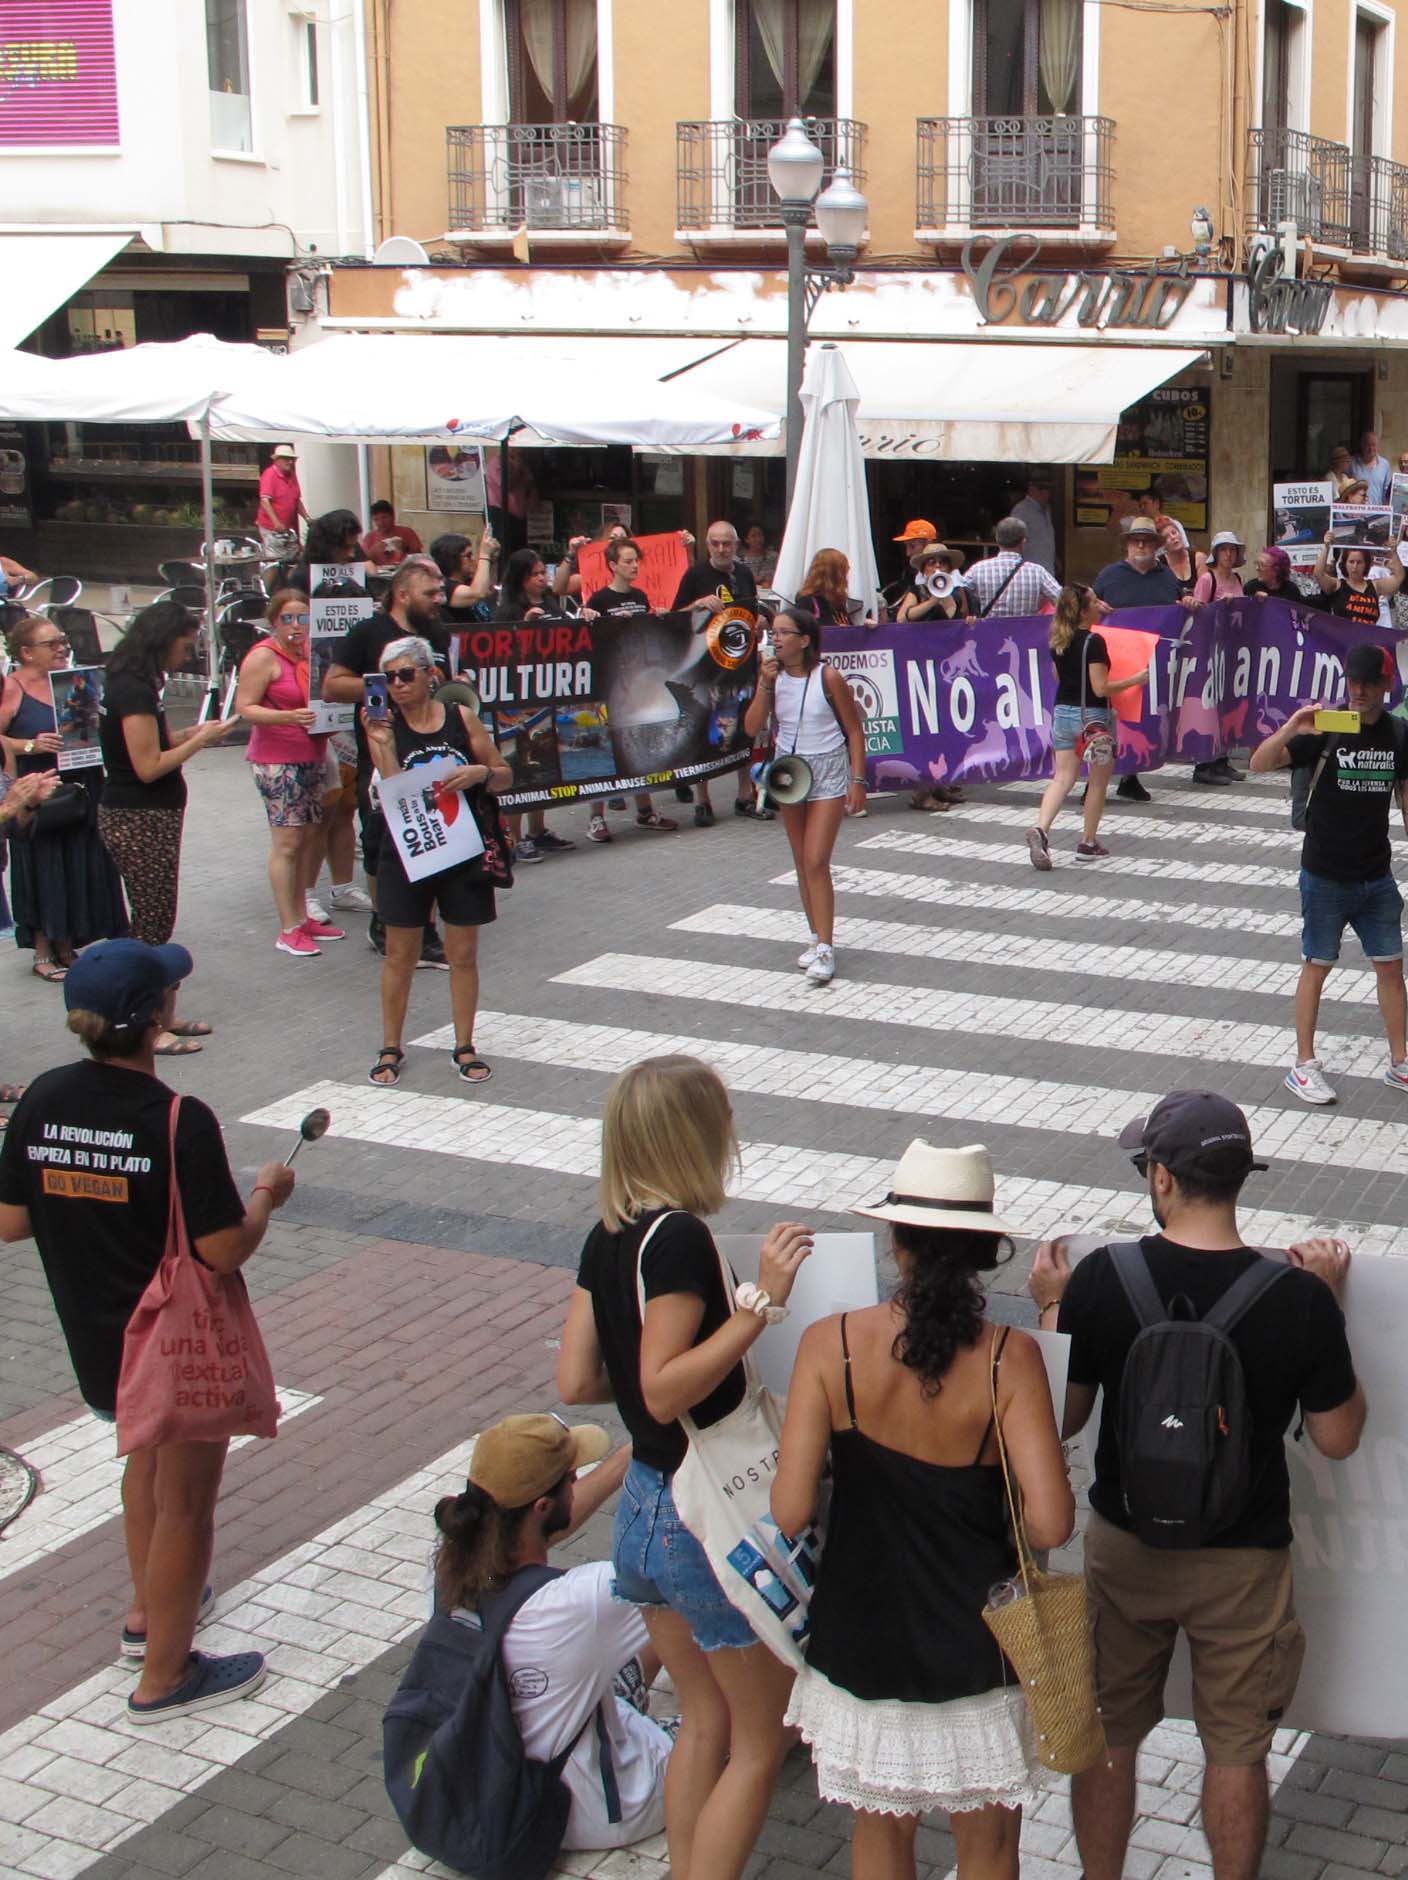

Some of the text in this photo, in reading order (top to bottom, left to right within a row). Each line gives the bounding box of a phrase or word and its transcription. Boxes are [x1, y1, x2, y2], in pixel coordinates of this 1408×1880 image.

[1281, 494, 1325, 504] TORTURA
[322, 567, 354, 577] NO ALS
[325, 604, 359, 616] ESTO ES
[316, 618, 365, 632] VIOLEN
[450, 626, 593, 659] TORTURA
[463, 660, 592, 703] ULTURA
[906, 658, 977, 736] No
[995, 648, 1044, 730] al
[1233, 631, 1391, 704] anim
[1357, 747, 1394, 760] anima
[1357, 759, 1395, 770] naturalis
[514, 789, 551, 805] ANIMAL
[550, 784, 577, 799] STOP
[578, 779, 614, 796] ANIMAL
[613, 775, 646, 791] ABUSE
[646, 769, 673, 786] STOP
[402, 827, 425, 858] NO
[429, 818, 447, 847] mar
[43, 1123, 133, 1149] LA REVOLUCIÓN
[27, 1145, 151, 1172] EMPIEZA EN TU PLATO
[48, 1174, 123, 1197] GO VEGAN
[160, 1337, 206, 1356] una
[175, 1386, 246, 1408] activa
